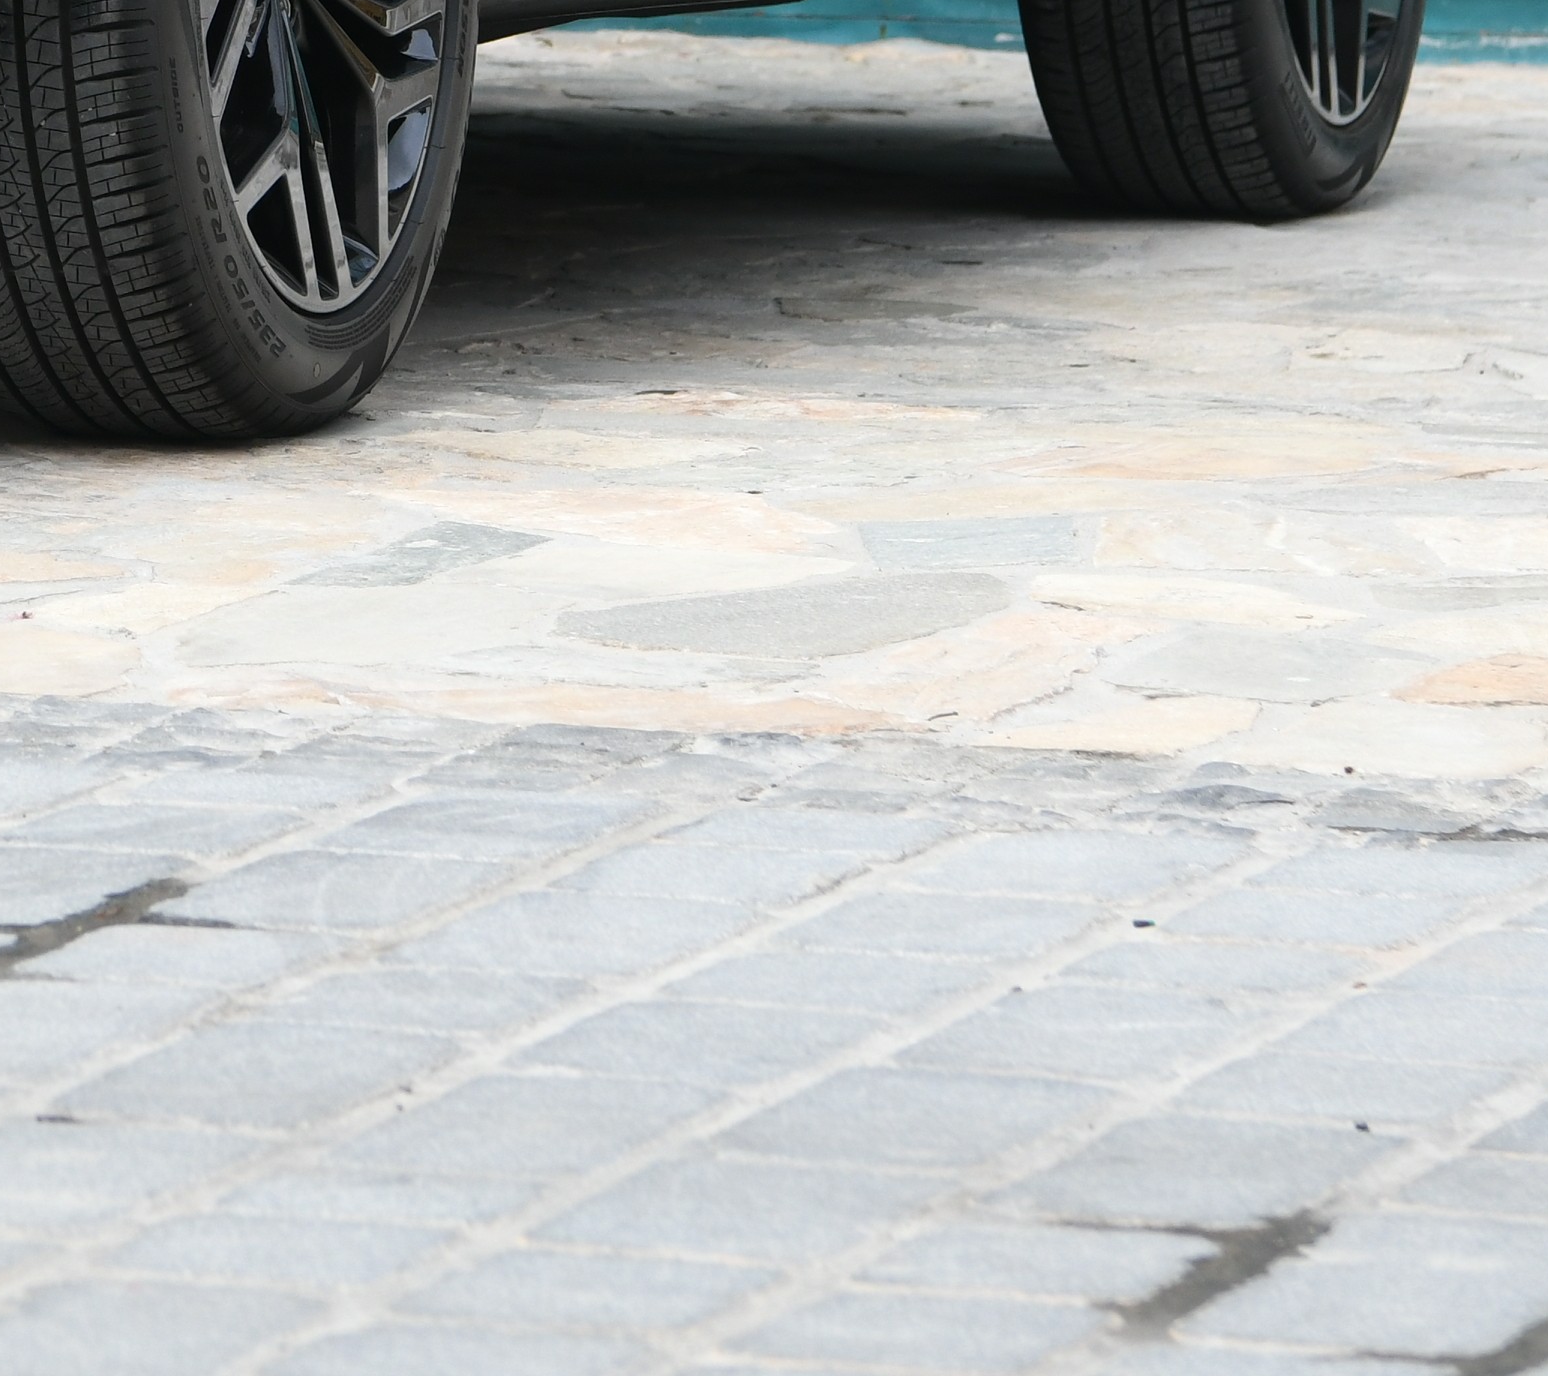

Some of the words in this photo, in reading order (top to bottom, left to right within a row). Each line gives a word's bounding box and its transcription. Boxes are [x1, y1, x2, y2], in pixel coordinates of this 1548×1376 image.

[169, 56, 184, 134] OUTSIDE
[196, 155, 227, 245] R20
[223, 254, 287, 359] 235/50
